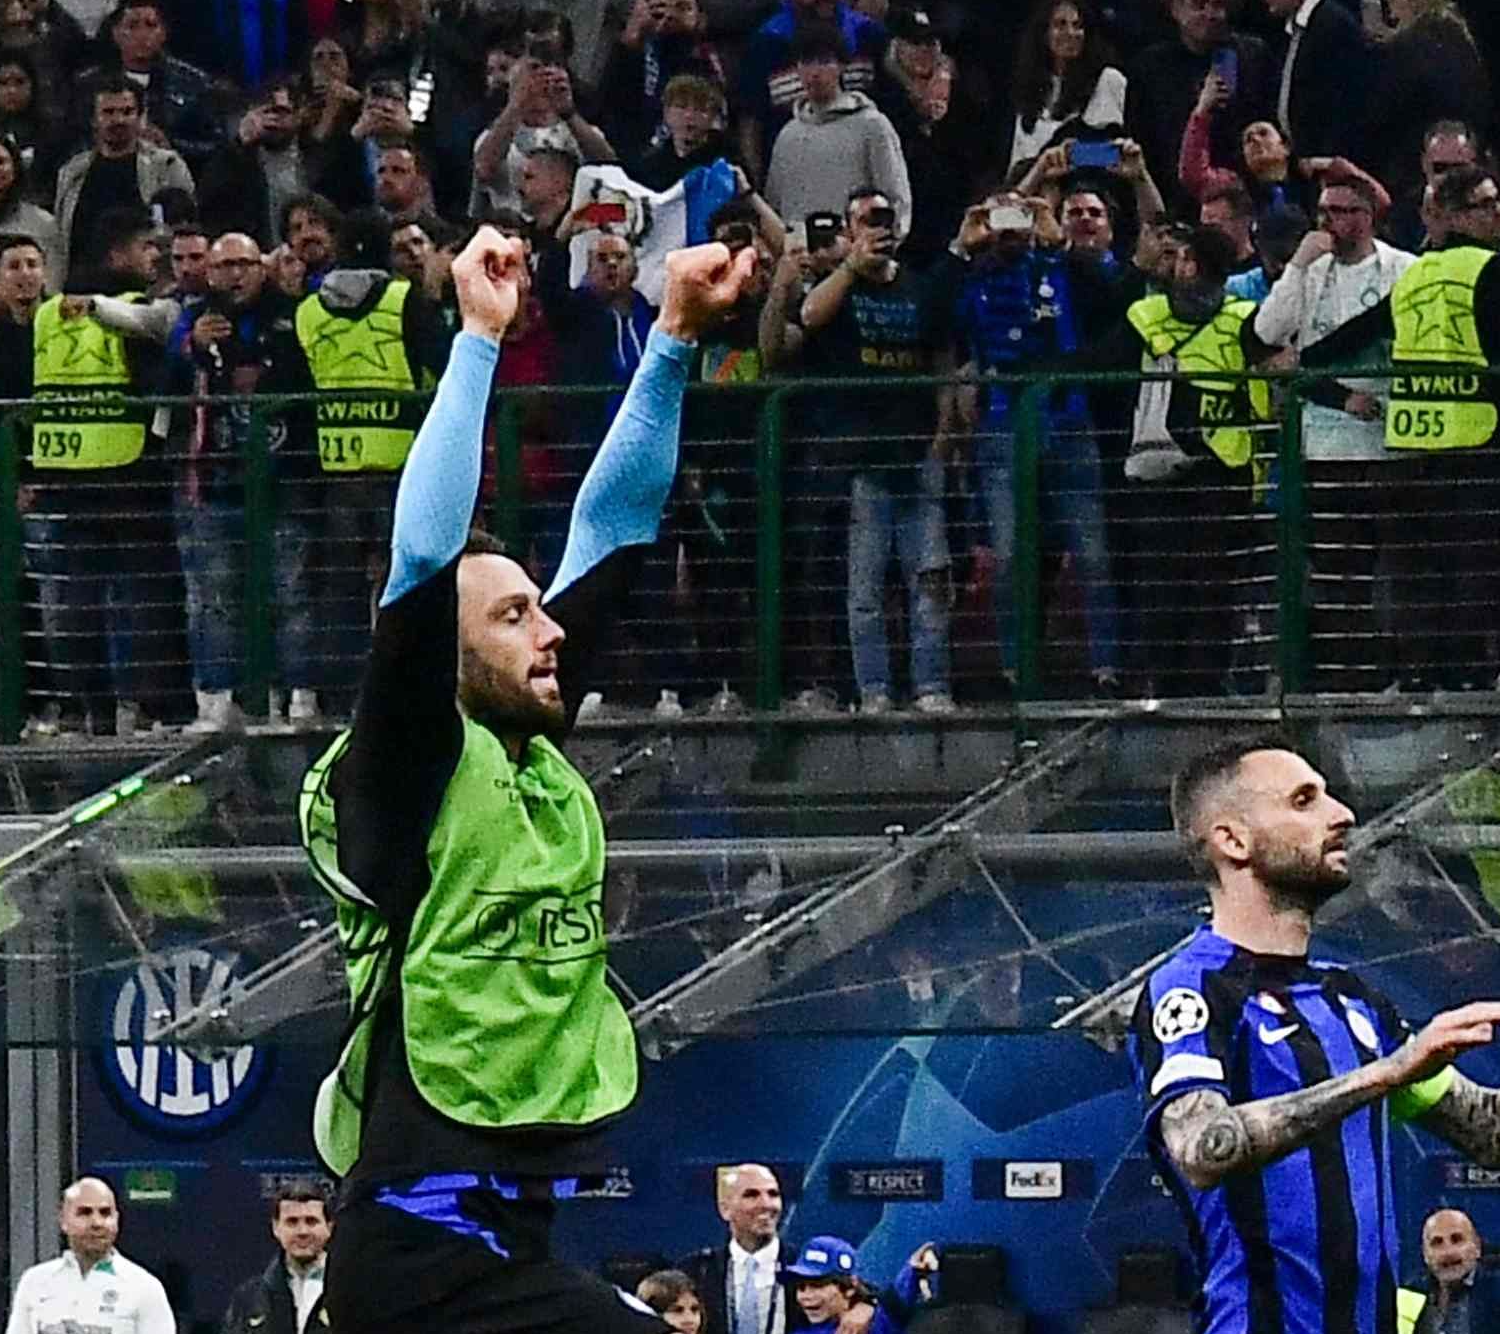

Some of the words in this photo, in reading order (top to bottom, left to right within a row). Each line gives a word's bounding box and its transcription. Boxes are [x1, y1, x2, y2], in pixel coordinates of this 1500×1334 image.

[1394, 409, 1445, 438] 055
[37, 432, 82, 458] 939
[868, 1173, 925, 1190] RESPECT
[1011, 1170, 1057, 1188] FedEx
